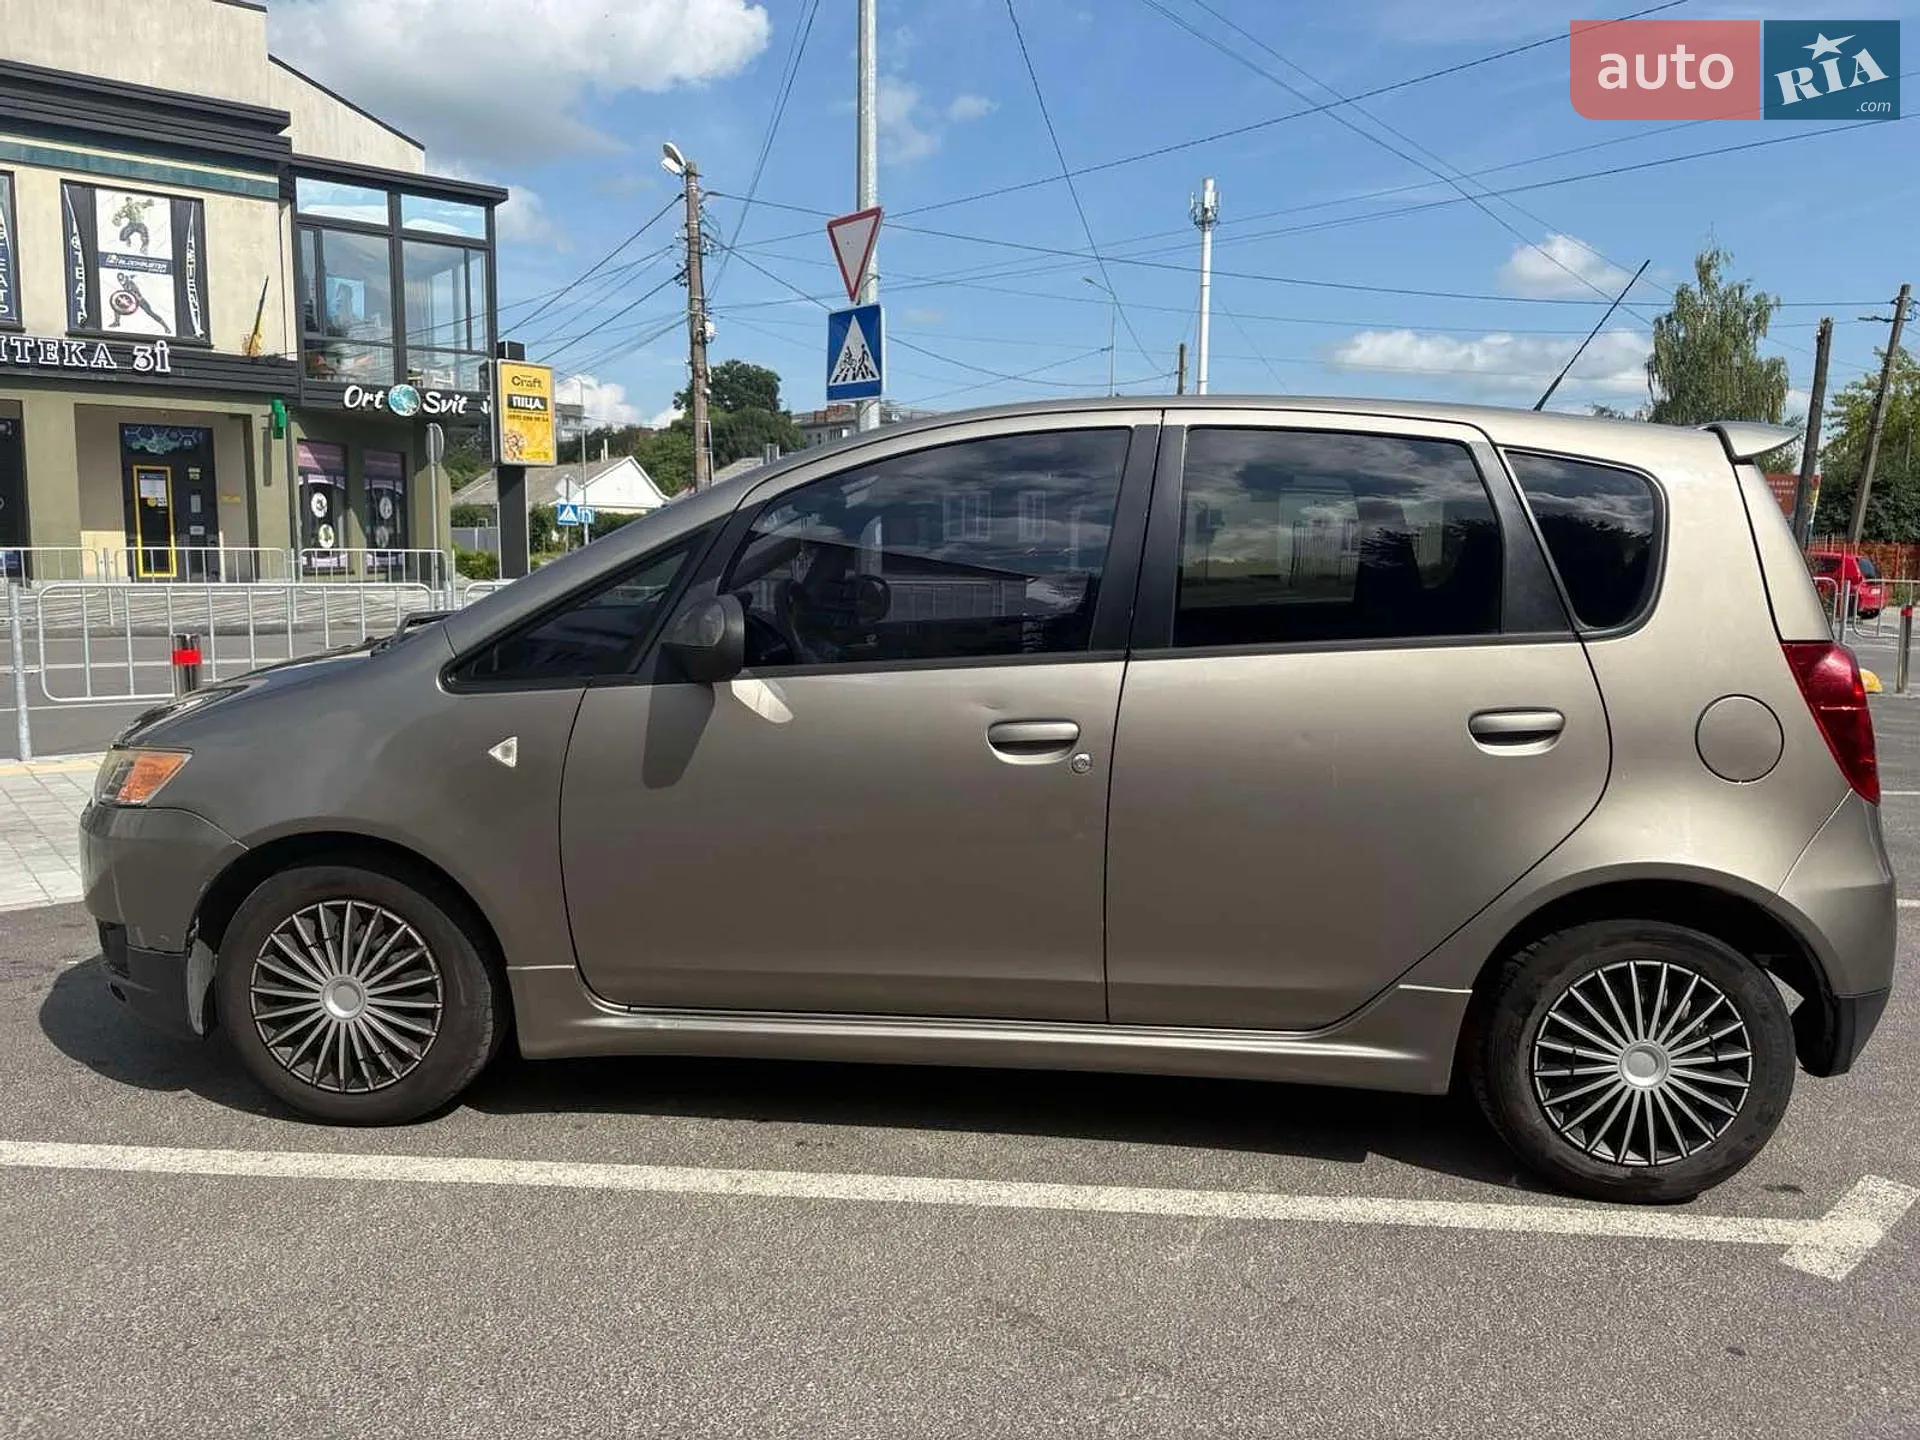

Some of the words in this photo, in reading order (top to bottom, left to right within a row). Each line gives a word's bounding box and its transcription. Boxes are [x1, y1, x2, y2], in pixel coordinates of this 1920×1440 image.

[0, 335, 117, 369] ТЕКА
[511, 375, 543, 390] Craft
[343, 385, 386, 409] Ort
[421, 391, 468, 414] Svit
